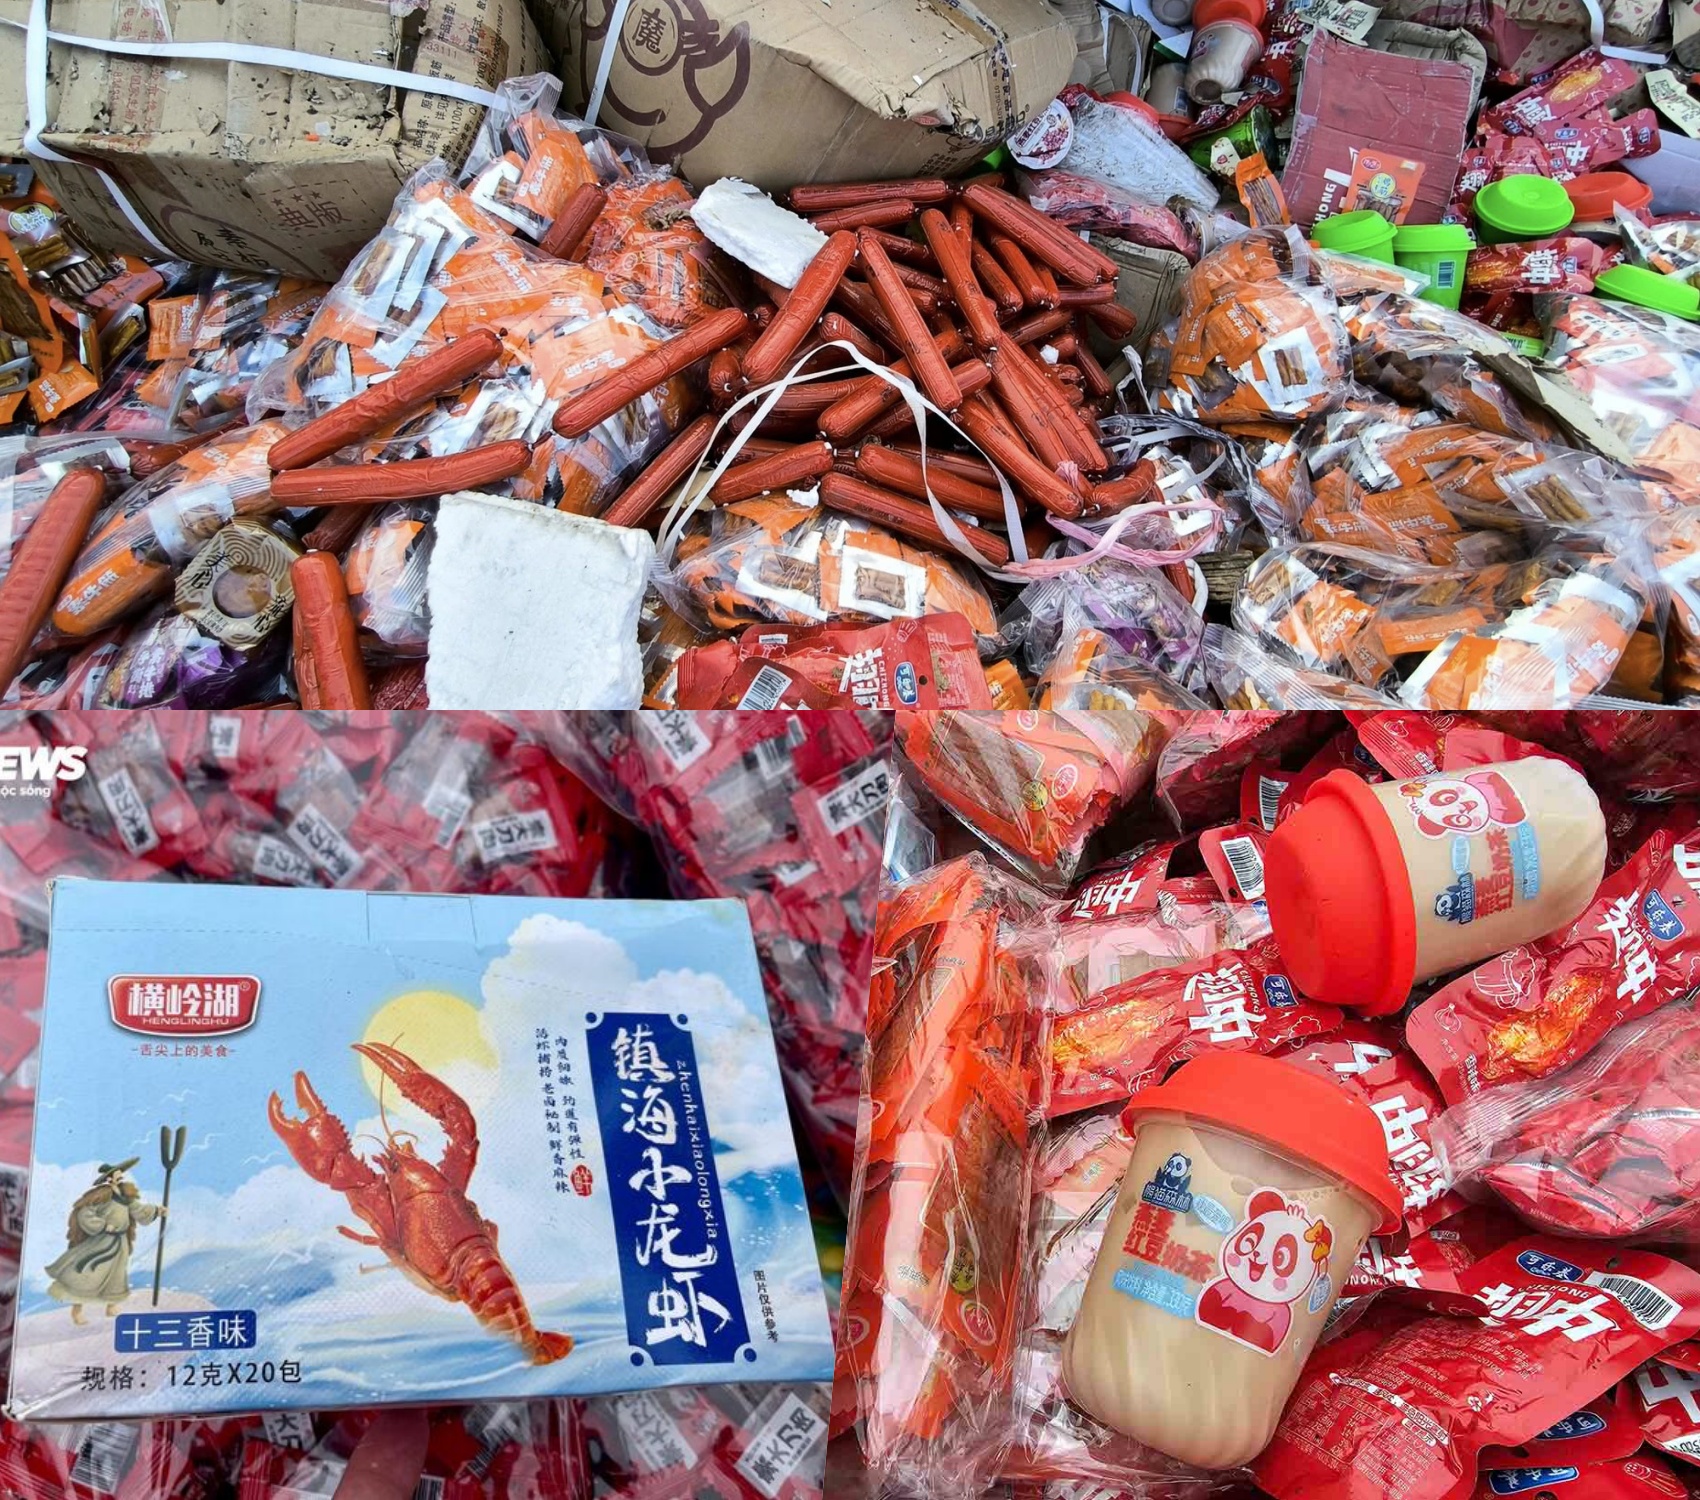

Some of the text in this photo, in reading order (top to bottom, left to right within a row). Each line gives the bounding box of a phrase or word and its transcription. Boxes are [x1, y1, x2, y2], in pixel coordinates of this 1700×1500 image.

[632, 11, 663, 54] 魔
[1310, 182, 1338, 235] HONG
[127, 983, 241, 1018] 横岭湖
[142, 1017, 230, 1027] HENGLINGHU
[611, 1023, 734, 1348] 镇海小龙虾
[753, 1270, 780, 1344] 图片仅供参考
[121, 1315, 248, 1350] 十三香味
